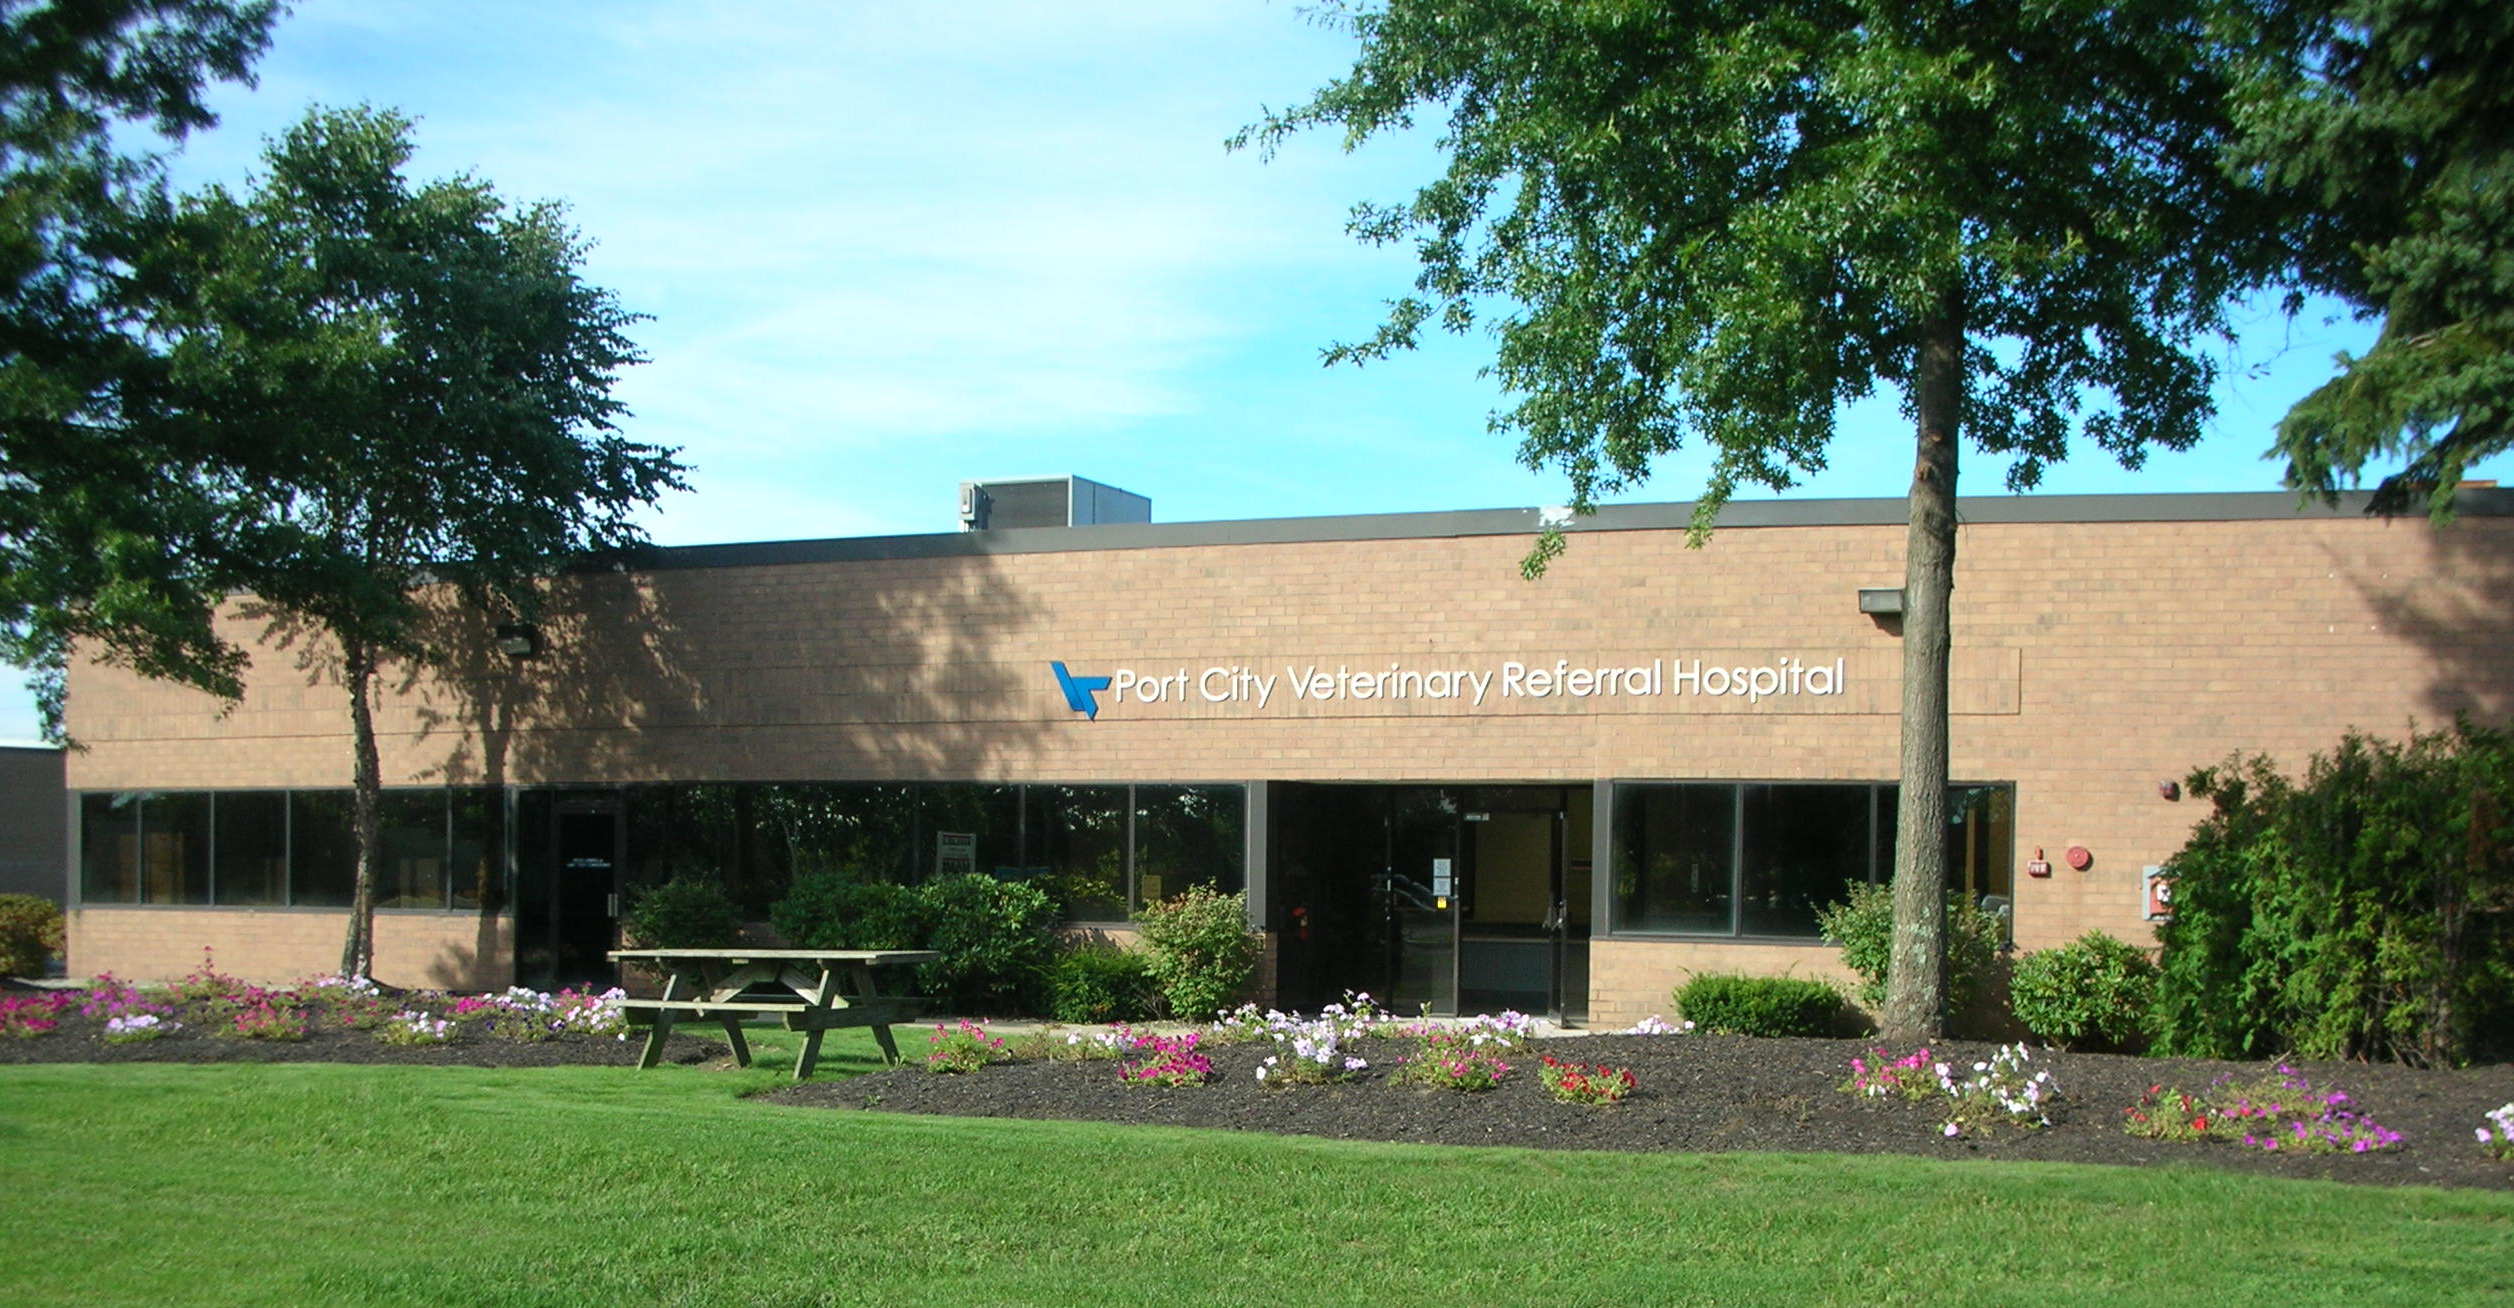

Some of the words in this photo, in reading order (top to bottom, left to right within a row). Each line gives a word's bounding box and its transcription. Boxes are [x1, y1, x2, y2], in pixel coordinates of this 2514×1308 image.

[1115, 668, 1190, 703] Port
[1199, 666, 1278, 709] City
[1287, 662, 1493, 706] Veterinary
[1502, 659, 1662, 698] Referral
[1673, 656, 1844, 704] Hospital
